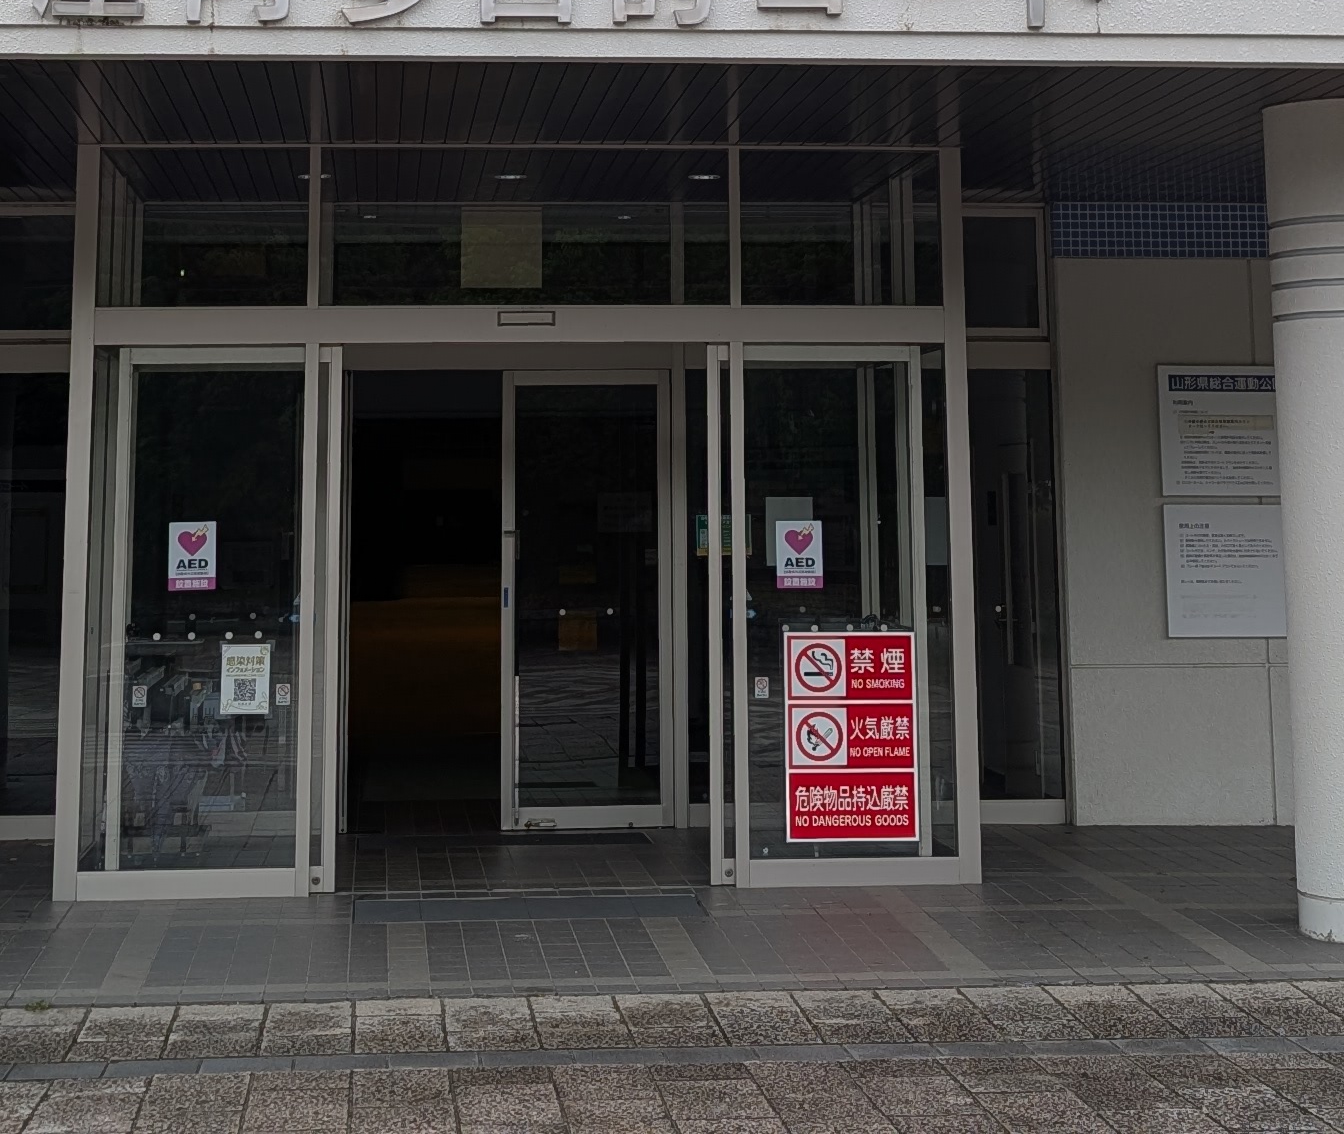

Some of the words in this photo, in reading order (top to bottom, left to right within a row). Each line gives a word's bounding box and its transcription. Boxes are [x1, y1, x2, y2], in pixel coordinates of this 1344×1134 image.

[1171, 376, 1276, 390] 山形県総合運動公
[176, 559, 209, 569] AED
[784, 557, 816, 567] AED
[226, 656, 266, 666] 感染対策
[850, 647, 905, 674] 禁煙
[851, 679, 864, 689] NO
[865, 679, 905, 689] SMOKING
[849, 715, 910, 740] 火気厳禁
[849, 747, 861, 757] NO
[862, 747, 883, 757] OPEN
[884, 747, 910, 757] FLAME
[794, 785, 909, 812] 危険物品持込厳禁
[795, 815, 810, 826] NO
[812, 815, 872, 826] DANGEROUS
[875, 815, 909, 826] GOODS
